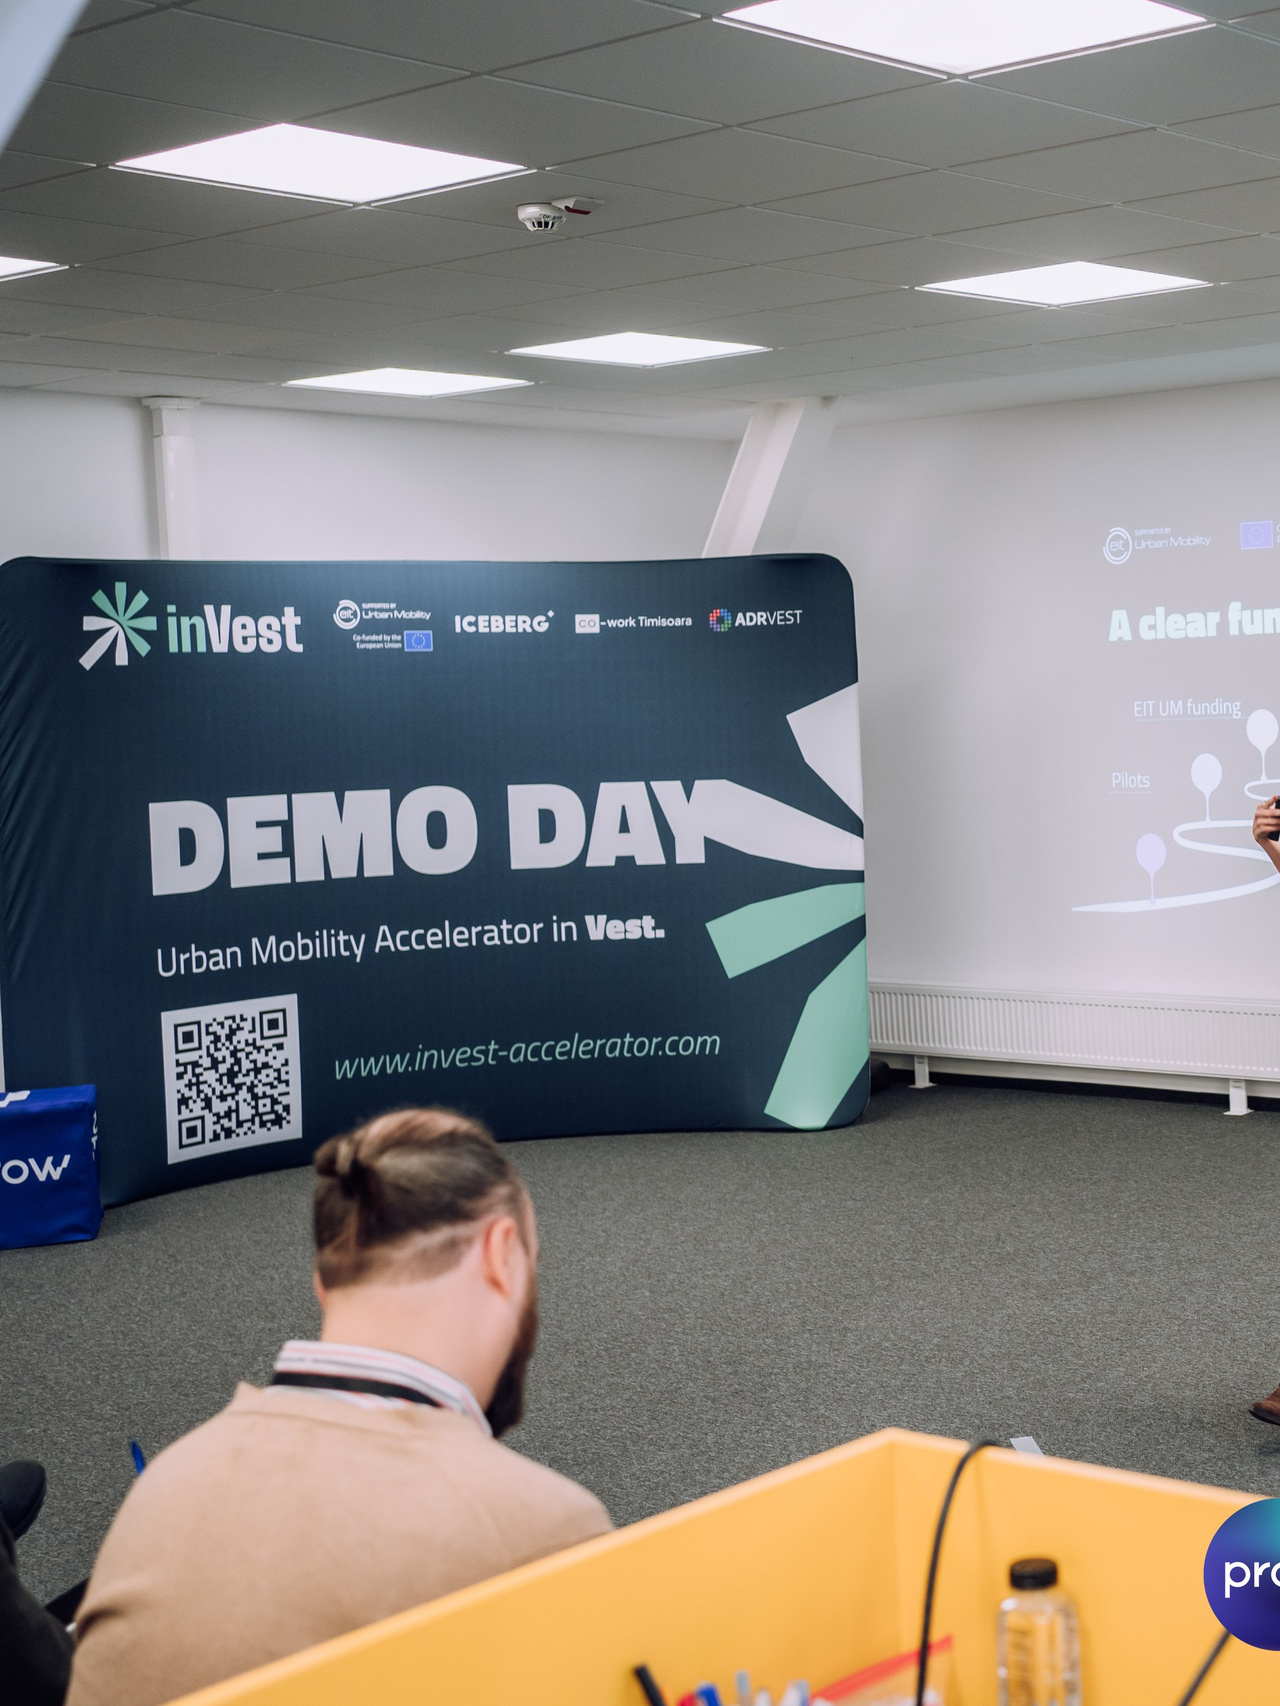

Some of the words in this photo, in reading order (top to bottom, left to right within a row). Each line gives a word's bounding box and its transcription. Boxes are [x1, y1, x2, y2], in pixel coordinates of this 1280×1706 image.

[1135, 539, 1168, 549] Urban
[1169, 535, 1211, 547] Mobility
[362, 610, 393, 619] Urban
[393, 609, 431, 620] Mobility
[638, 615, 693, 627] Timisoara
[735, 610, 802, 626] ADRVEST
[1108, 609, 1132, 641] A
[1138, 606, 1220, 640] clear
[166, 604, 304, 653] inVest
[352, 633, 382, 642] Co-funded
[383, 633, 391, 642] by
[391, 633, 402, 641] the
[356, 641, 383, 650] European
[384, 641, 402, 649] Union
[1134, 701, 1156, 717] EIT
[1159, 700, 1183, 716] UM
[1187, 698, 1242, 719] funding
[1112, 772, 1151, 788] Pilots
[149, 785, 478, 896] DEMO
[507, 779, 722, 869] DAY
[157, 943, 242, 977] Urban
[251, 929, 366, 963] Mobility
[375, 920, 544, 953] Accelerator
[552, 915, 577, 942] in
[584, 914, 665, 941] Vest.
[334, 1033, 721, 1080] www.invest-accelerator.com
[0, 1154, 71, 1184] ow
